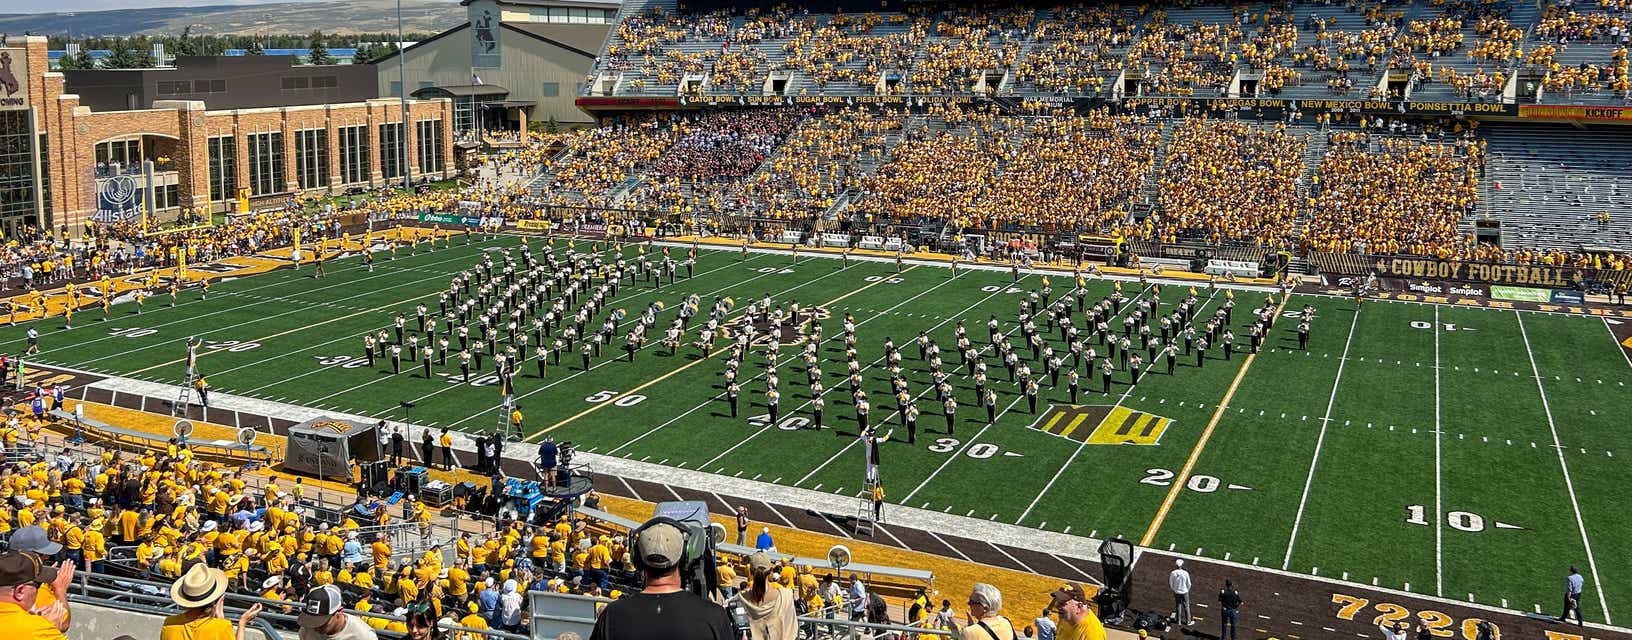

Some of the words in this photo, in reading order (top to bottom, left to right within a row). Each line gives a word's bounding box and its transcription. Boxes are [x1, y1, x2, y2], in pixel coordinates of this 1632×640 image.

[0, 97, 24, 106] OMING
[1260, 99, 1286, 107] BOWL
[1301, 100, 1323, 109] NEW
[1325, 101, 1362, 109] MEXICO
[1364, 101, 1393, 110] BOWL
[1409, 102, 1472, 111] POINSETTIA
[1475, 103, 1507, 112] BOWL
[1585, 108, 1624, 119] KICKOFF
[92, 202, 147, 222] Allstate
[1391, 259, 1462, 280] COWBOY
[1468, 263, 1567, 287] FOOTBALL
[1409, 283, 1442, 293] Simplot
[1450, 286, 1483, 296] Simplot
[585, 390, 647, 407] 50
[747, 413, 811, 431] 40
[927, 437, 1001, 459] 30
[1138, 468, 1221, 493] 20
[1406, 504, 1486, 533] 10
[1332, 593, 1501, 640] 7220
